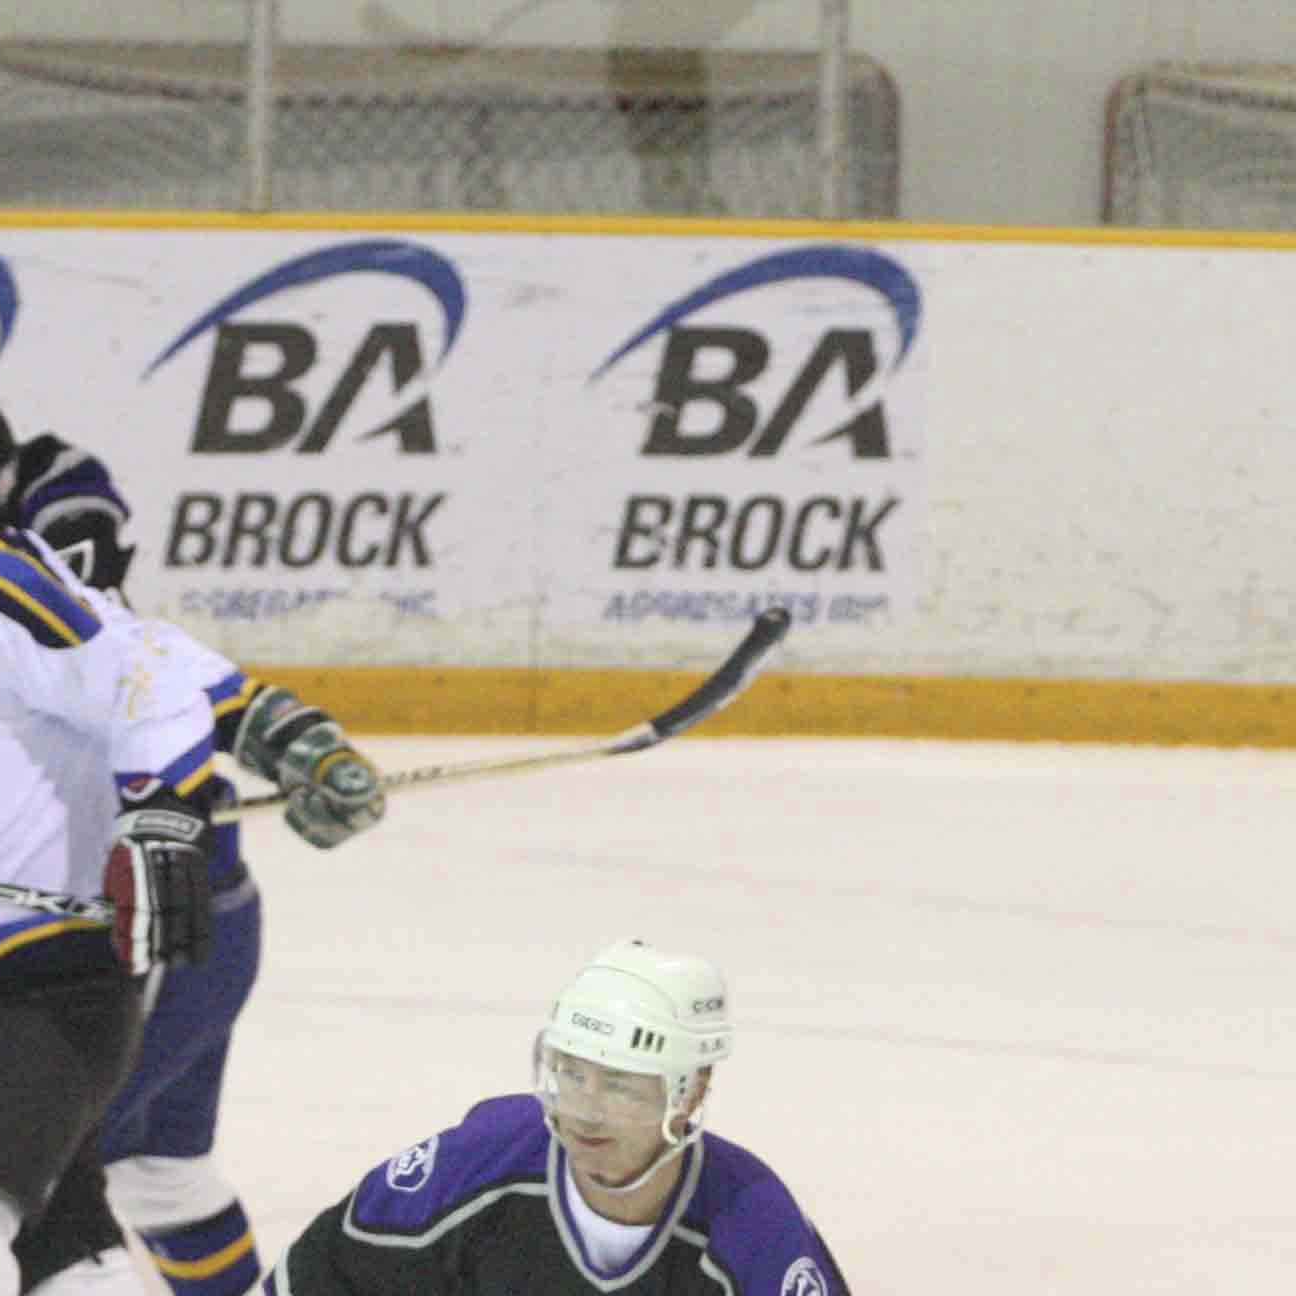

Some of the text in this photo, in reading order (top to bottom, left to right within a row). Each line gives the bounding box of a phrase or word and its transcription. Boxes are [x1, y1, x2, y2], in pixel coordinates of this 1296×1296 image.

[190, 322, 436, 454] BA
[639, 325, 892, 458] BA
[164, 492, 446, 569] BROCK
[612, 493, 902, 572] BROCK
